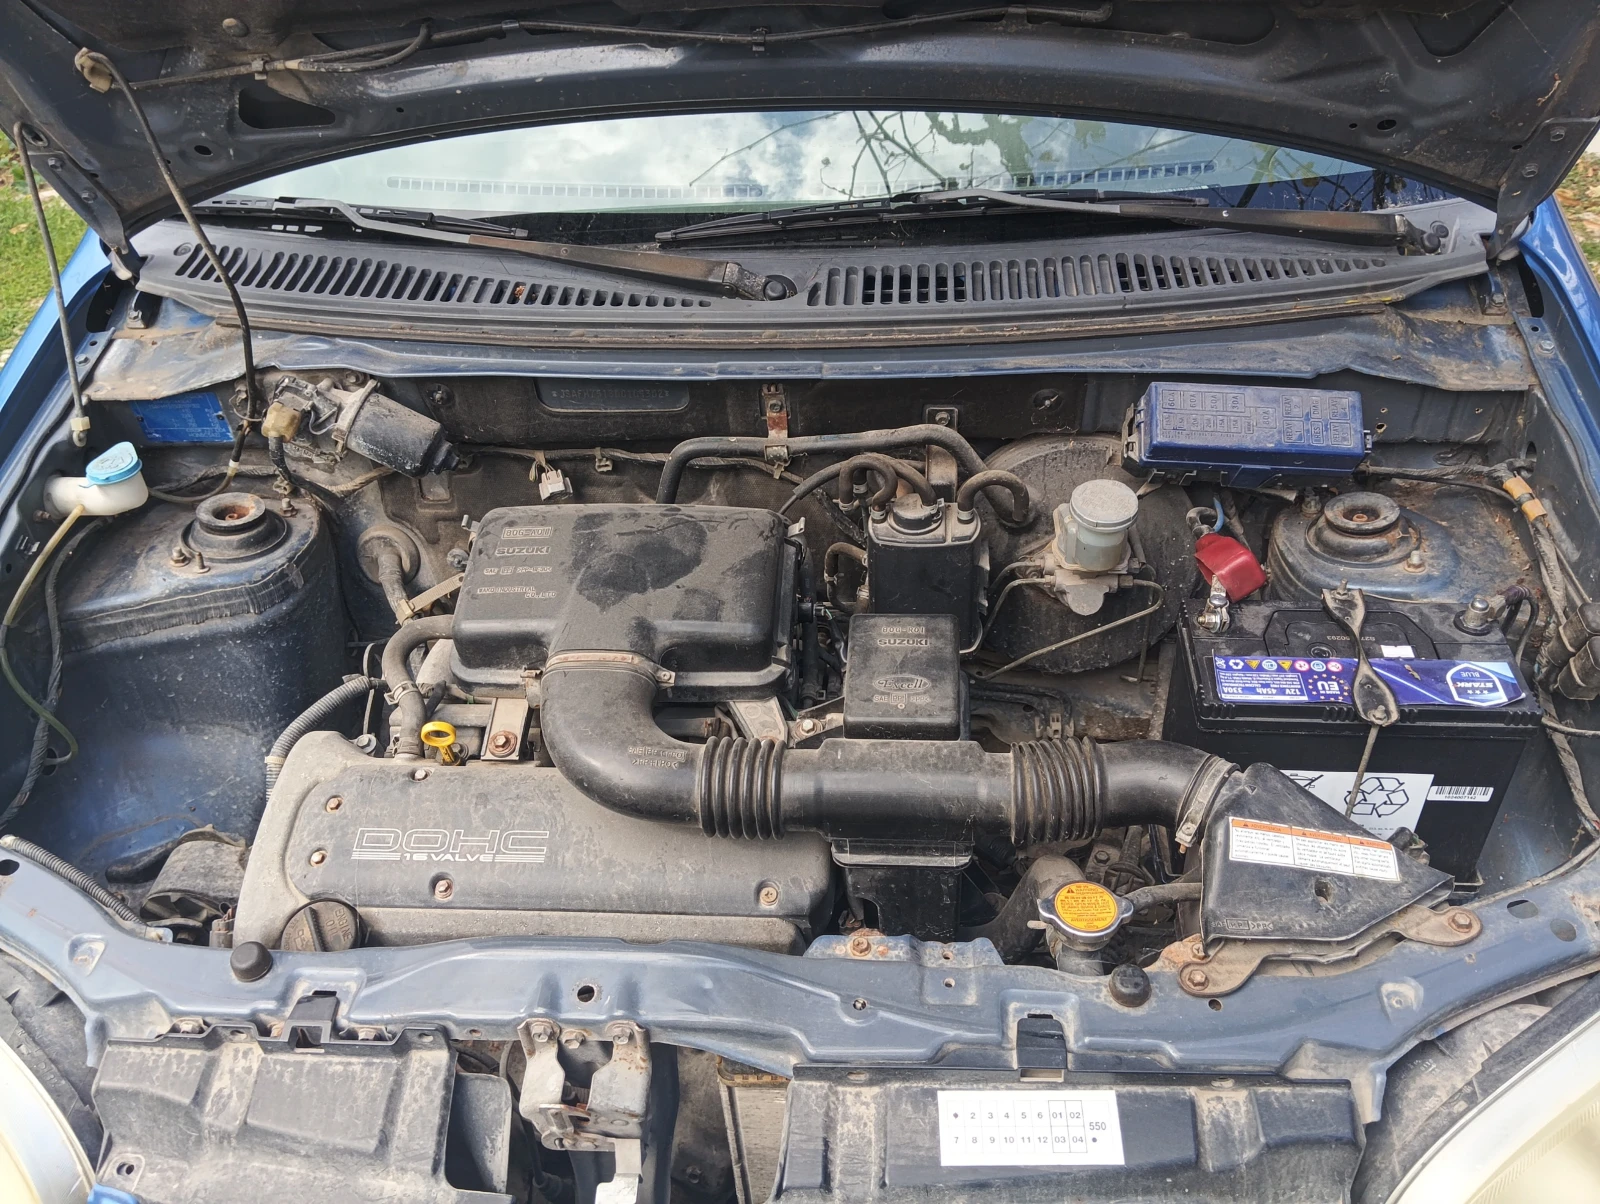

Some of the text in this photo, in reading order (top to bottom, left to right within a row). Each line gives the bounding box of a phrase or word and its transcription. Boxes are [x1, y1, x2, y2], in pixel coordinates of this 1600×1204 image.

[1284, 397, 1292, 415] RELAY
[1312, 400, 1320, 415] DIAG
[1331, 399, 1339, 417] RELAY
[1313, 426, 1321, 439] RES
[1332, 424, 1340, 442] RELAY
[496, 547, 550, 556] SUZUKI
[1317, 680, 1339, 691] EU
[353, 828, 549, 854] DOHC
[325, 920, 339, 936] OIL
[335, 907, 354, 942] ENGINE
[1089, 1122, 1106, 1131] 550
